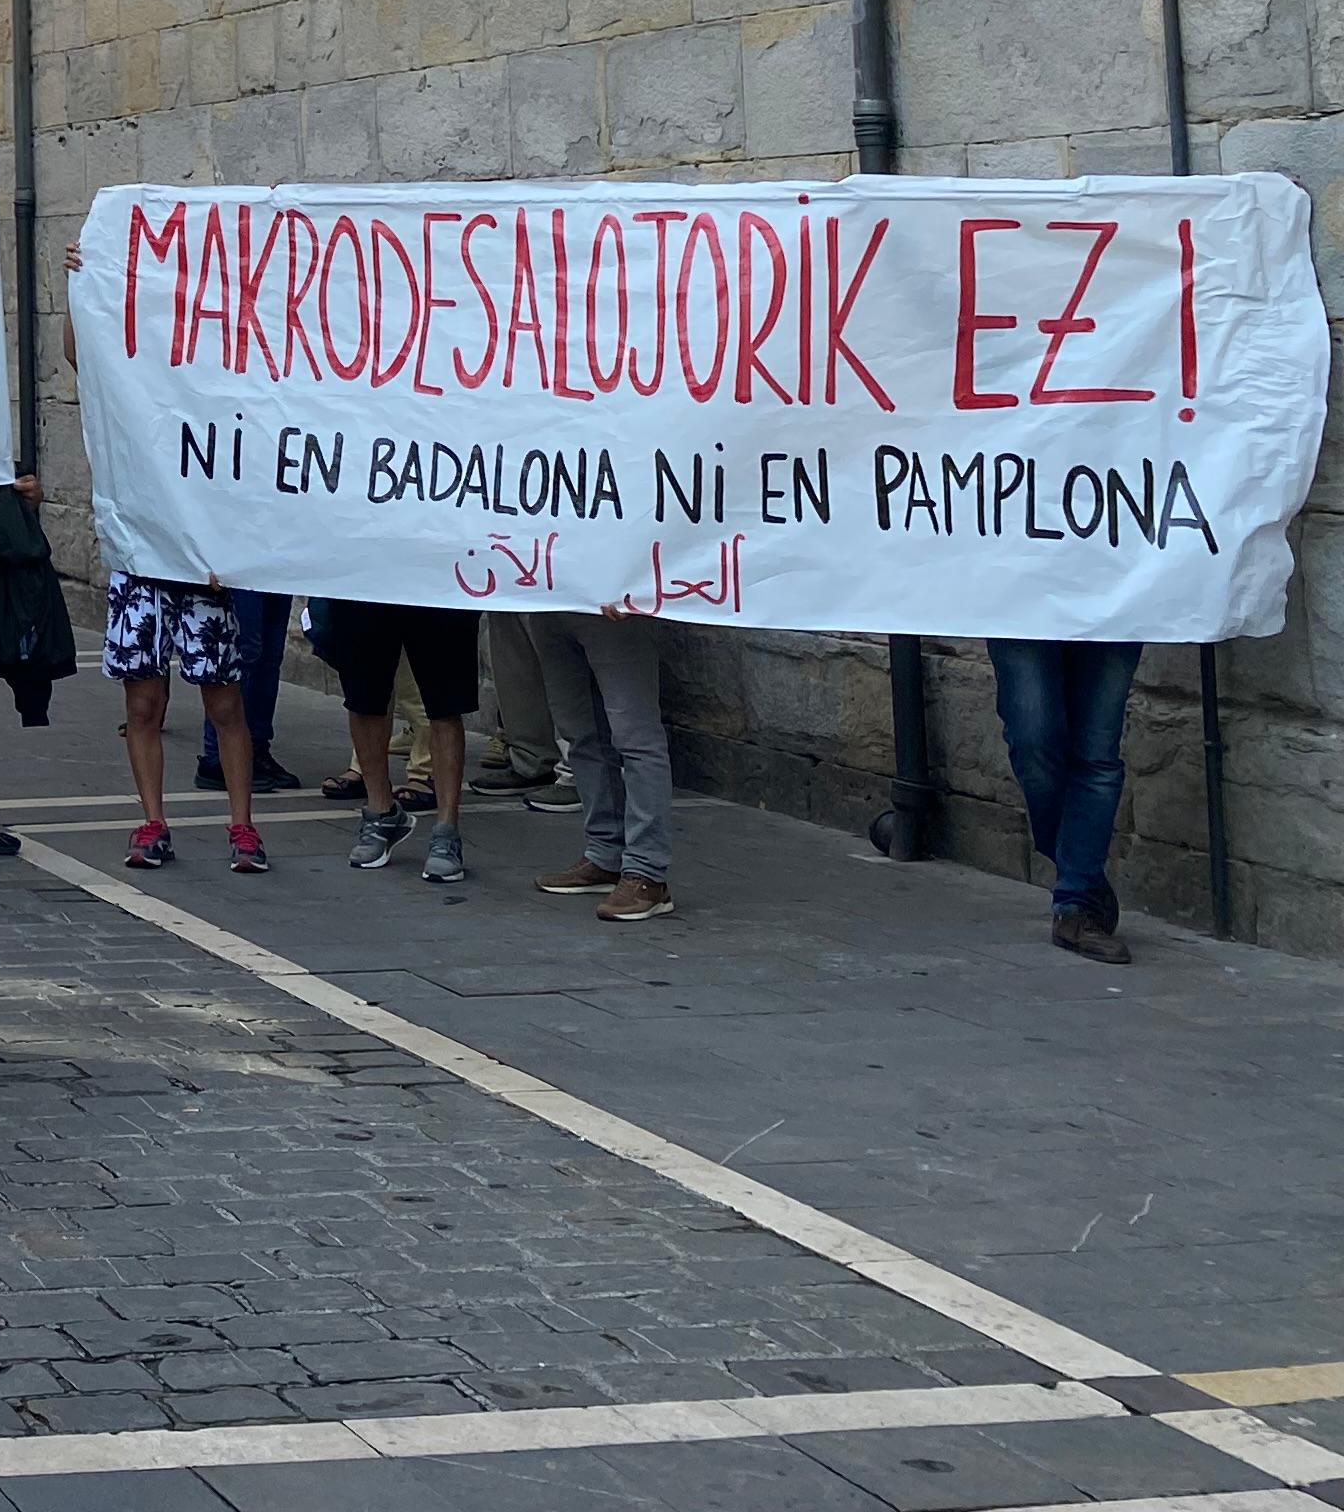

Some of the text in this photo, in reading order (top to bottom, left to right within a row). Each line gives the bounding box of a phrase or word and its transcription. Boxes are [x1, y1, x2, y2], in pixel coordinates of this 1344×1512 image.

[276, 425, 344, 497] EN
[367, 435, 624, 521] BADALONA
[761, 446, 831, 525] EN
[874, 443, 1221, 557] PAMPLONA
